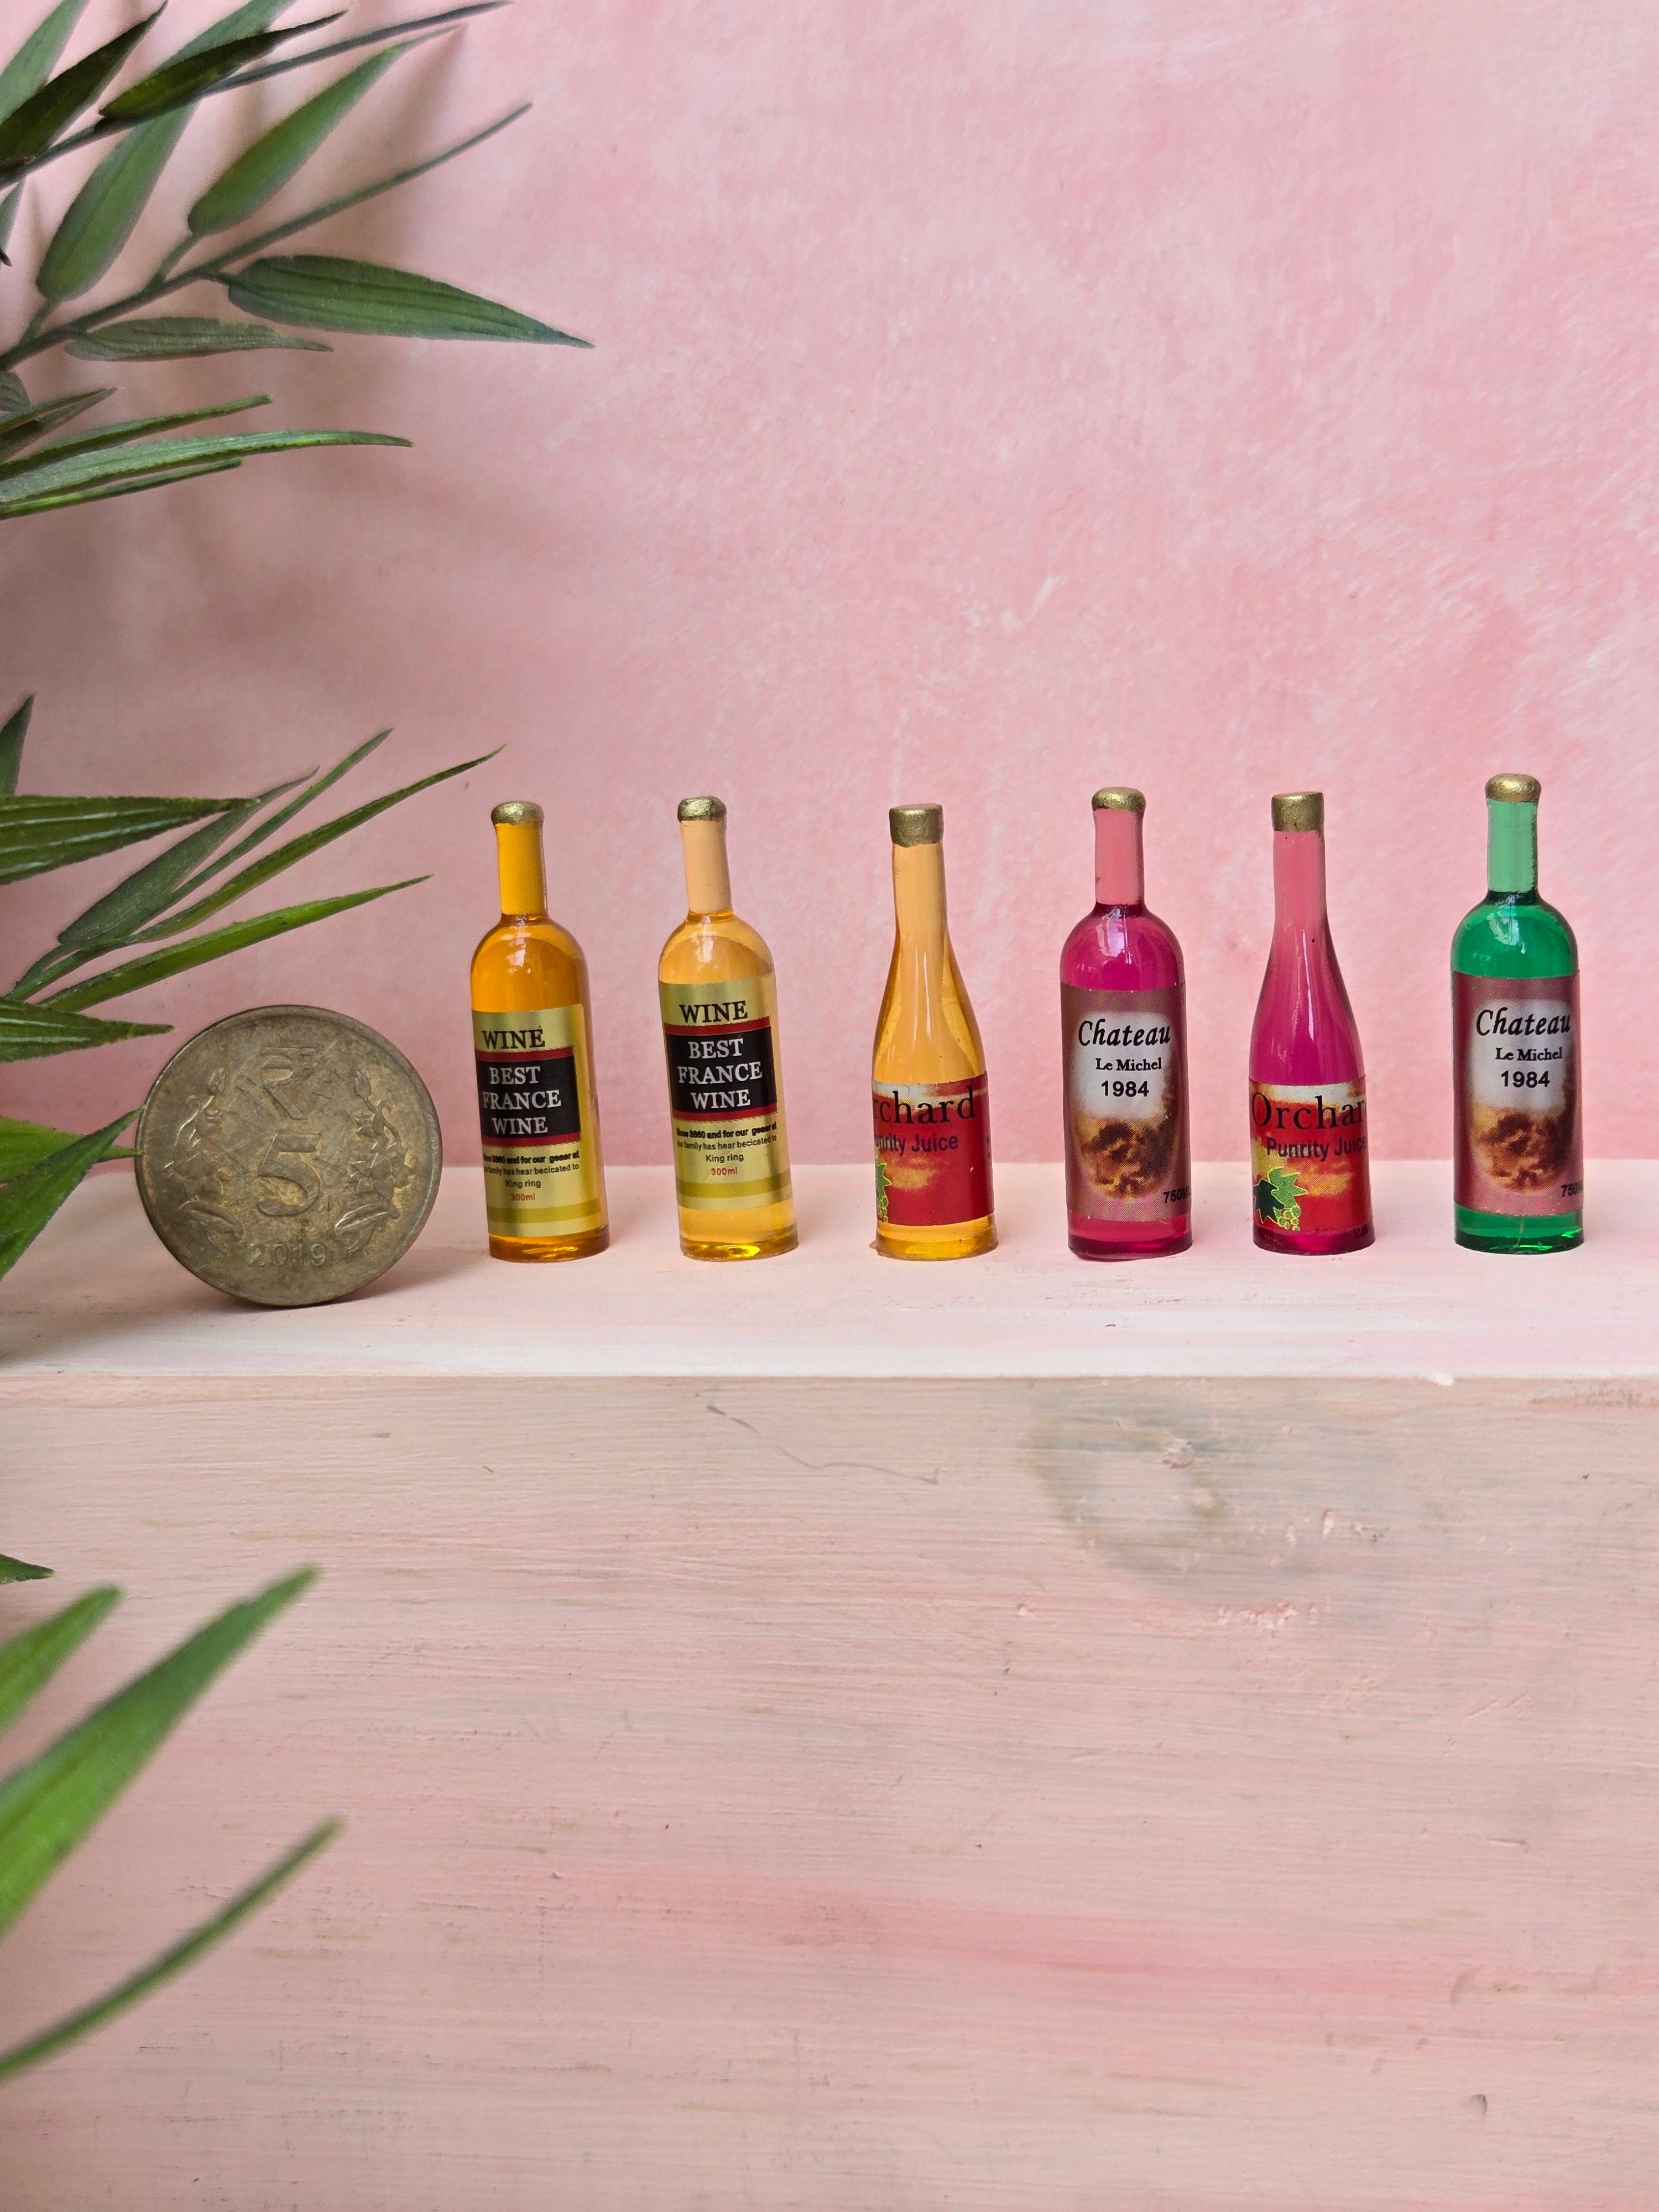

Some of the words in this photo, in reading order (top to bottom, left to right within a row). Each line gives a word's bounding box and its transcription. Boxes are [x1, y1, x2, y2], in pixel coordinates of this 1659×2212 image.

[679, 1000, 748, 1023] WINE
[1476, 1007, 1571, 1036] Chateau
[482, 1028, 545, 1049] WINE
[1079, 1019, 1171, 1046] Chateau
[688, 1038, 744, 1059] BEST
[1495, 1048, 1515, 1061] Le
[1517, 1047, 1563, 1061] Michel
[677, 1061, 763, 1084] FRANCE
[1095, 1058, 1113, 1071] Le
[1116, 1057, 1162, 1071] Michel
[489, 1066, 541, 1084] BEST
[1500, 1071, 1550, 1088] 1984
[1101, 1081, 1149, 1097] 1984
[483, 1090, 562, 1110] FRANCE
[691, 1089, 751, 1109] WINE
[873, 1086, 976, 1124] rchard
[1251, 1092, 1365, 1130] Orchar
[492, 1117, 548, 1135] WINE
[703, 1142, 716, 1150] has
[911, 1134, 959, 1152] Juice
[1334, 1135, 1366, 1156] Juice
[706, 1154, 725, 1164] King
[727, 1153, 744, 1162] ring
[257, 1132, 321, 1217] 5
[503, 1167, 515, 1176] has
[711, 1167, 738, 1176] 300ml
[505, 1179, 523, 1189] King
[524, 1180, 541, 1188] ring
[511, 1192, 536, 1202] 300ml
[247, 1243, 327, 1266] 2019
